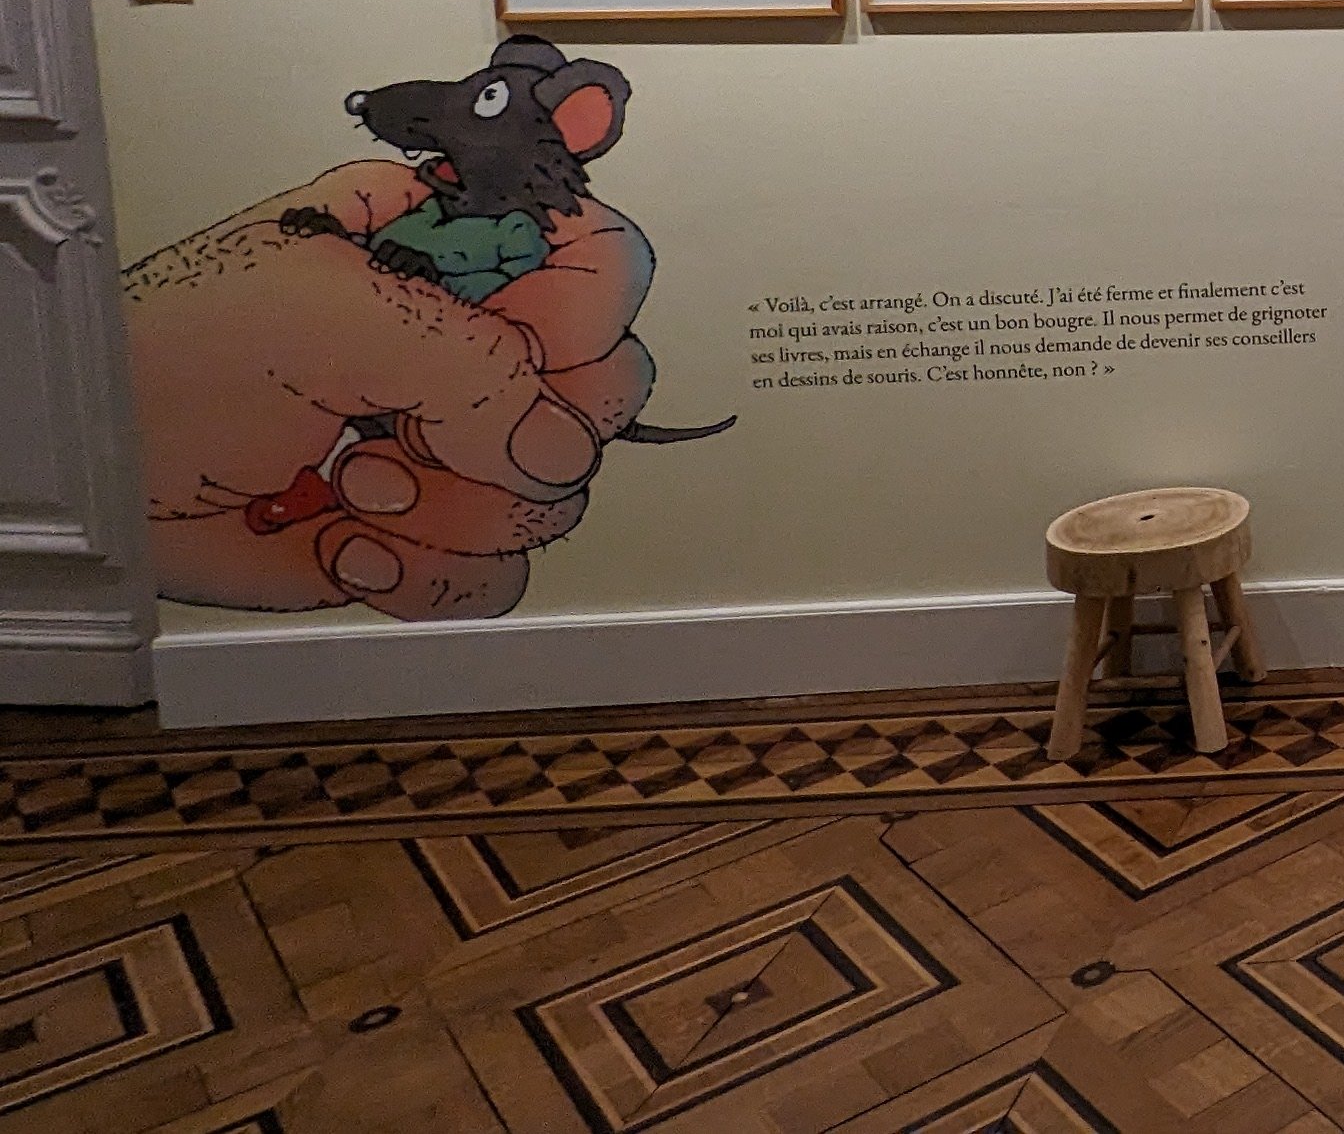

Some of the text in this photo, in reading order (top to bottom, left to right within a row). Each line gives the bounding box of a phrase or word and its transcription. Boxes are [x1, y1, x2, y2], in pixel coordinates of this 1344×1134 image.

[764, 297, 814, 314] Voilà,
[860, 295, 927, 314] arrangé.
[933, 291, 961, 307] On
[966, 296, 974, 306] a
[979, 290, 1044, 306] discuté.
[1077, 287, 1102, 303] été
[1107, 285, 1153, 302] ferme
[1158, 288, 1173, 300] et
[1178, 282, 1267, 299] finalement
[750, 324, 784, 339] moi
[788, 324, 817, 343] qui
[822, 321, 862, 337] avais
[867, 321, 923, 336] raison,
[968, 319, 990, 331] un
[996, 314, 1029, 330] bon
[1034, 312, 1097, 332] bougre.
[1103, 310, 1114, 326] Il
[1120, 312, 1160, 326] nous
[1165, 309, 1224, 329] permet
[1228, 305, 1248, 322] de
[1252, 305, 1327, 326] grignoter
[751, 328, 1316, 364] ses livres, mais en échange il nous demande de devenir ses conseillers
[753, 378, 773, 389] en
[778, 372, 838, 388] dessins
[842, 368, 863, 385] de
[867, 368, 922, 384] souris.
[974, 364, 1048, 379] honnête,
[1052, 365, 1085, 377] non
